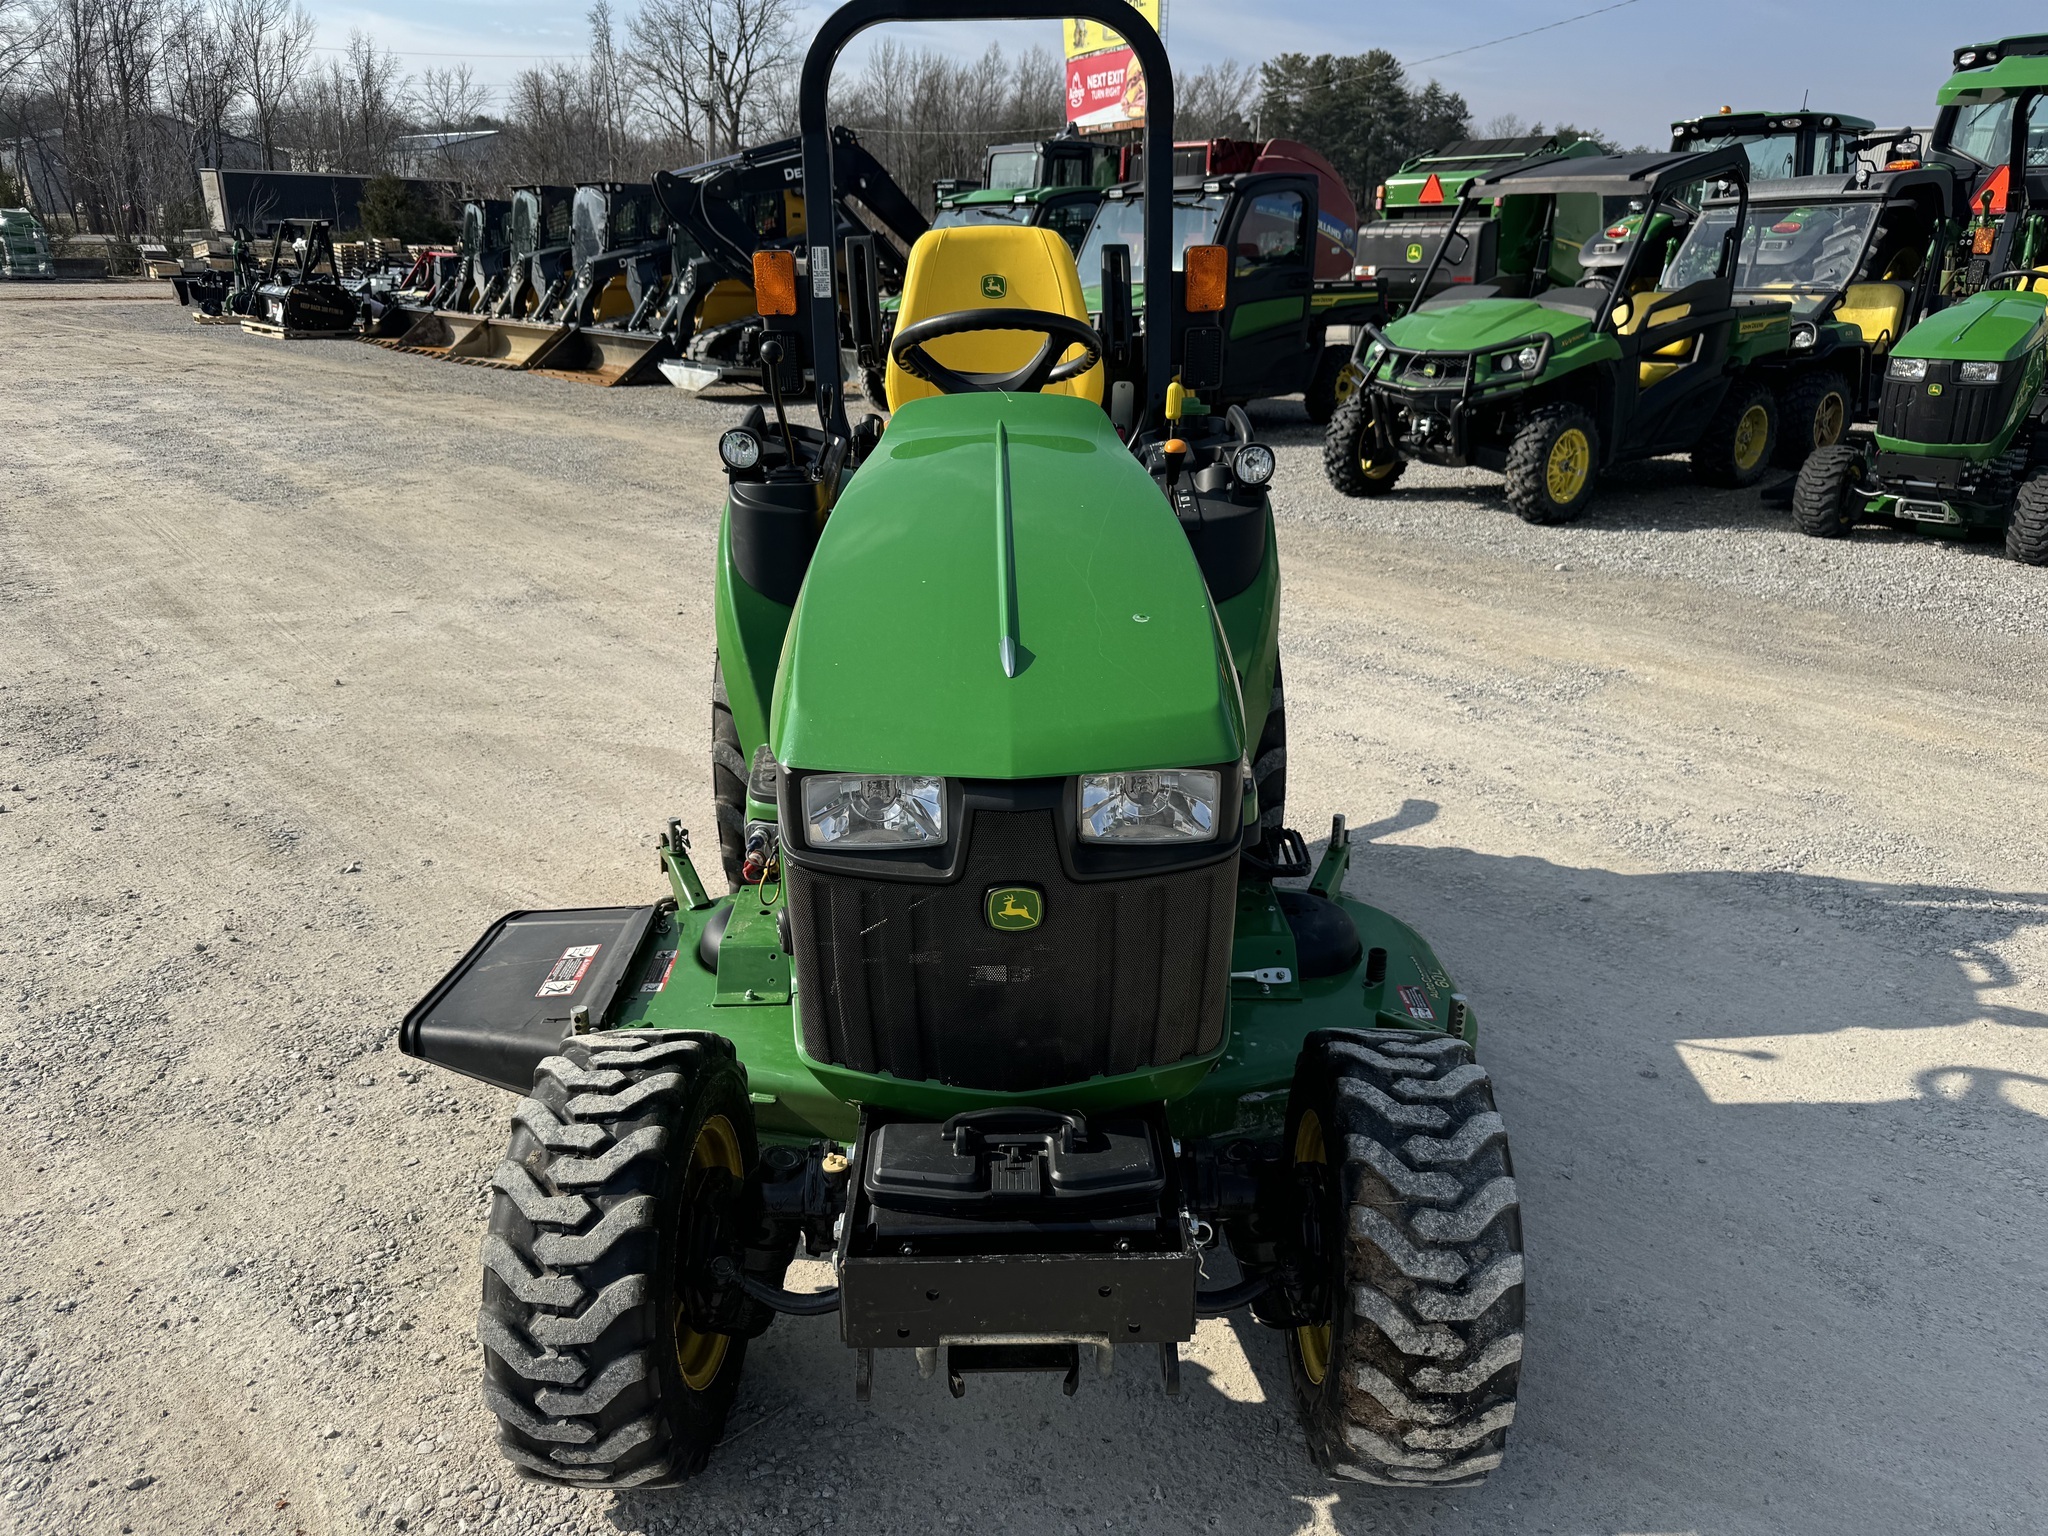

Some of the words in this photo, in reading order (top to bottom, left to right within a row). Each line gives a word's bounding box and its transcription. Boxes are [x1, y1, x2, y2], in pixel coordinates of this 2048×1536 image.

[1087, 72, 1107, 90] NEXT
[1107, 69, 1126, 86] EXIT
[1091, 89, 1105, 101] TURN
[1105, 85, 1121, 98] RIGHT
[1317, 219, 1341, 240] OLLAND
